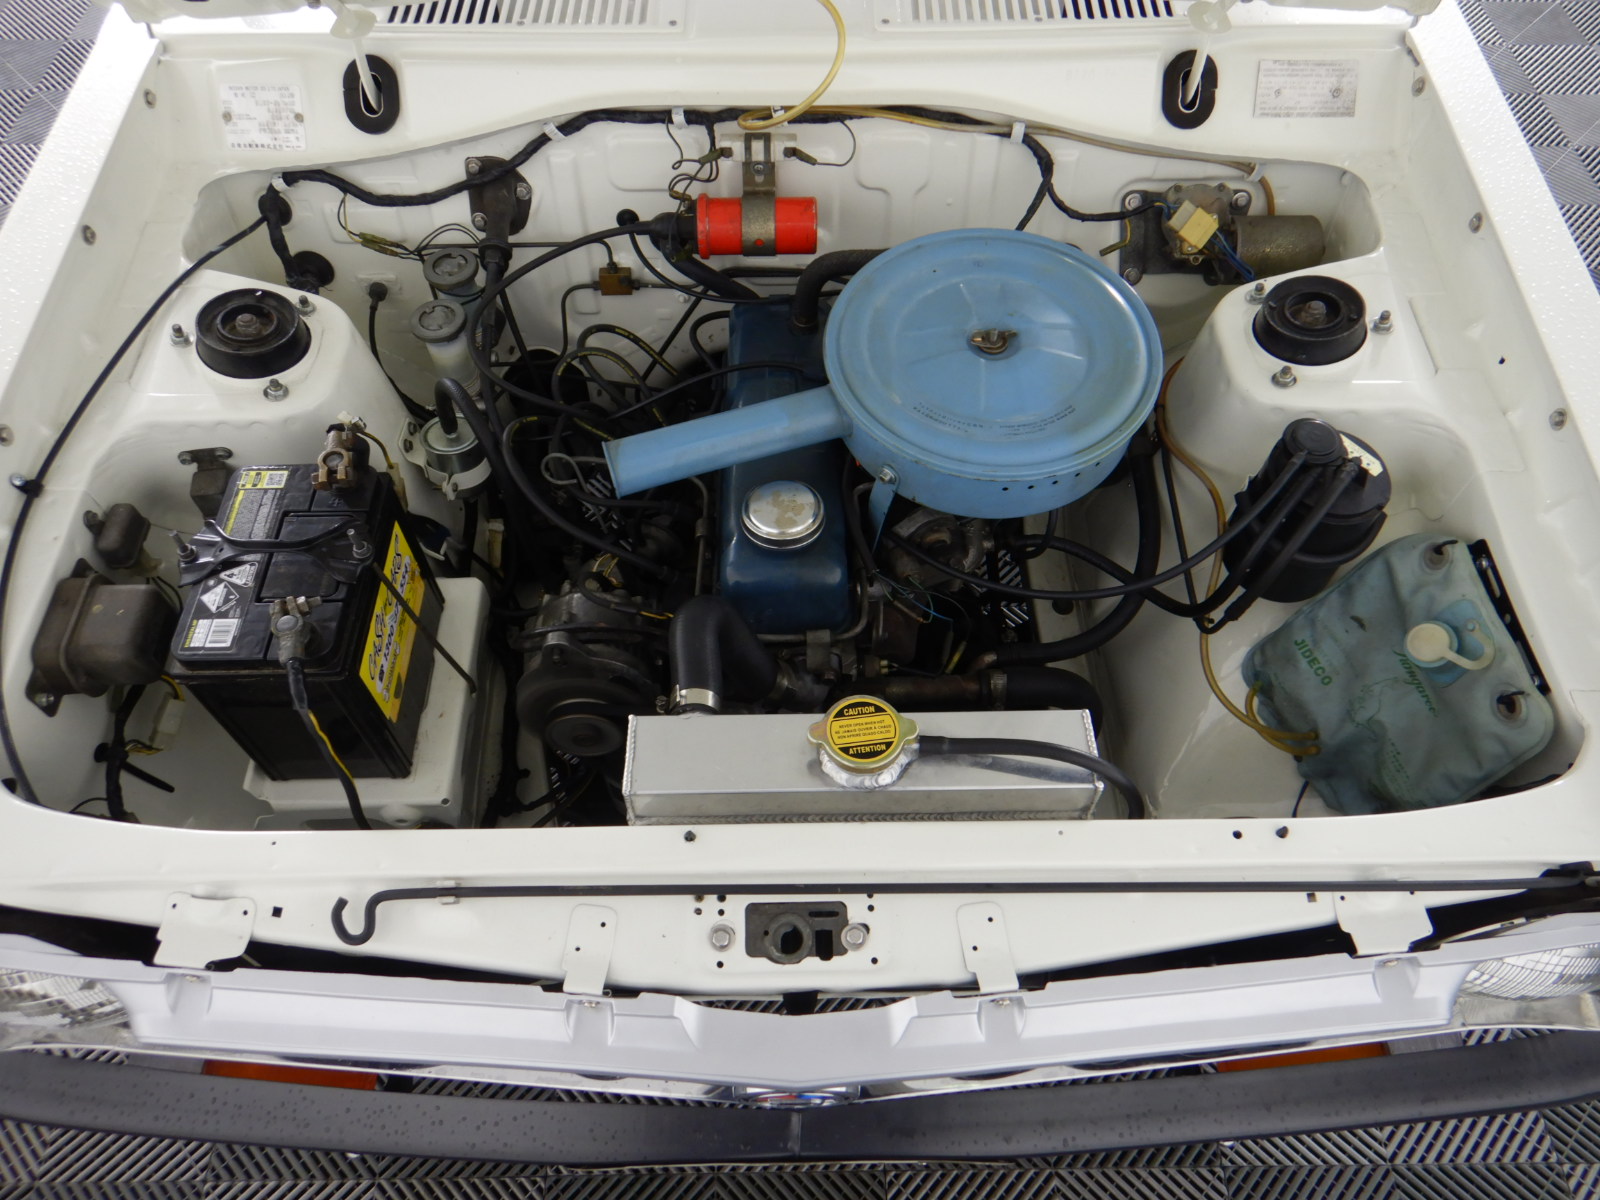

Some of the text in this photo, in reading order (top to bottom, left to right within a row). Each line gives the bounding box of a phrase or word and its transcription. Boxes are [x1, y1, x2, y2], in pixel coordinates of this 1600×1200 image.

[1294, 638, 1333, 687] JIDECO
[843, 706, 875, 716] CAUTION
[849, 744, 886, 755] ATTENTION
